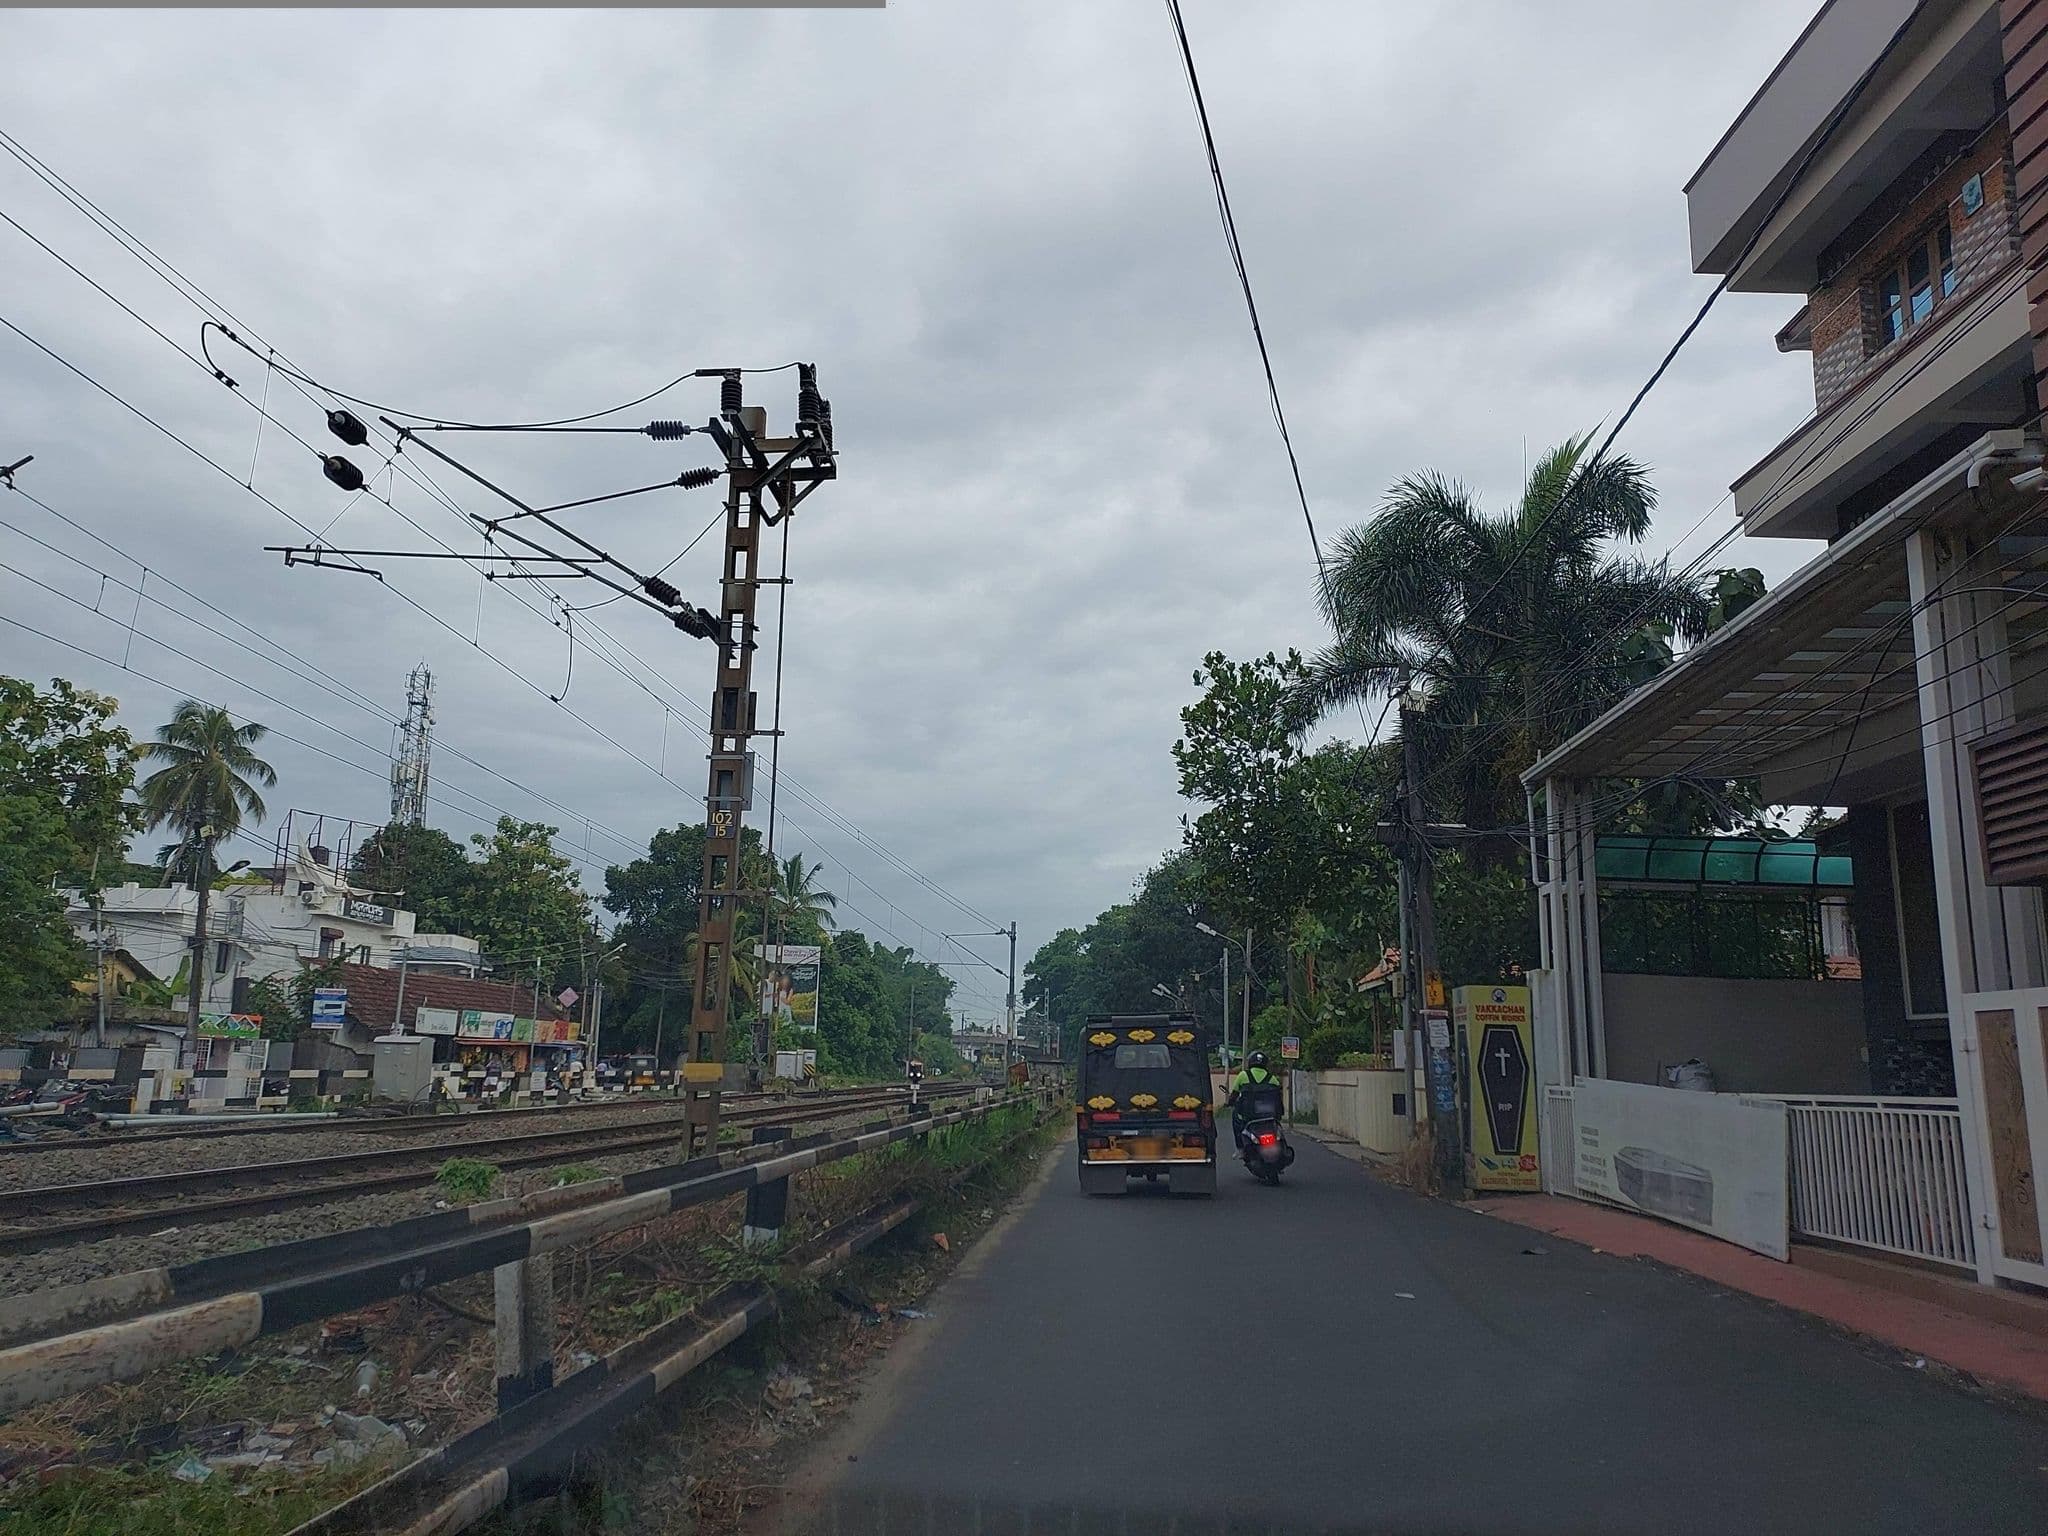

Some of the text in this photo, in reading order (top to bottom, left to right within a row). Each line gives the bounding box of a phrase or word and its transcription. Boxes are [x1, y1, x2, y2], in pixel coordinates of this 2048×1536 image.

[712, 812, 733, 824] 102
[715, 825, 726, 837] 15
[1475, 1005, 1525, 1014] VAKKACHAN
[1502, 1014, 1525, 1022] WORKS
[1498, 1103, 1513, 1112] RIP
